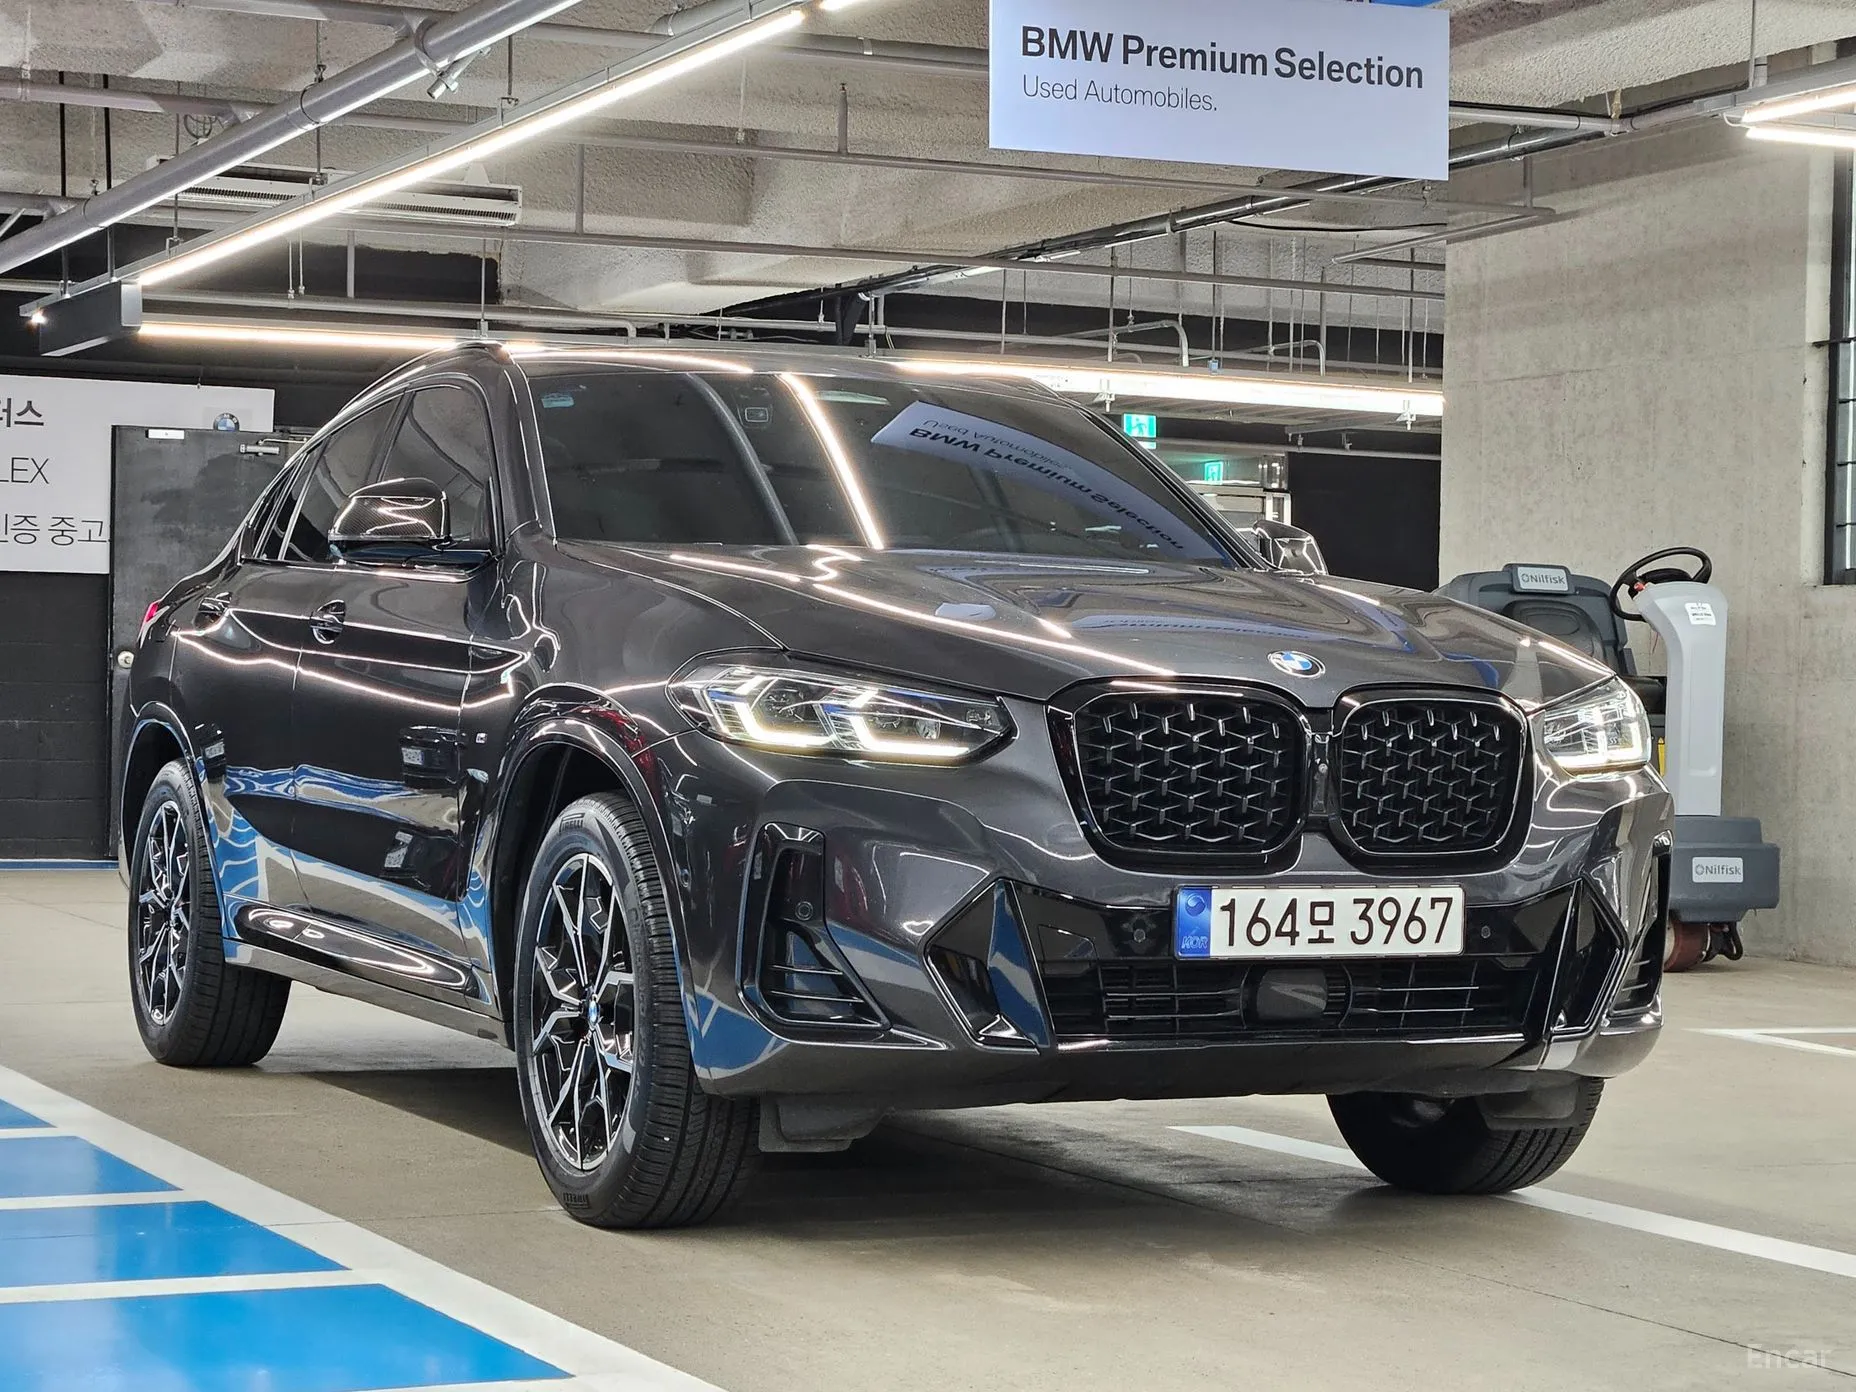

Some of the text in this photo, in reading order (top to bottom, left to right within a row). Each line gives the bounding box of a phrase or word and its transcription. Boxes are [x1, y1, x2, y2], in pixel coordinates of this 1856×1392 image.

[1021, 25, 1423, 89] BMW Premium Selection
[1023, 74, 1218, 112] Used Automobiles.
[47, 516, 110, 546] 중고
[1530, 574, 1566, 585] Nilfisk
[1705, 864, 1742, 876] Nilfisk
[1220, 896, 1454, 947] 164모 3967
[1181, 935, 1209, 949] KOR
